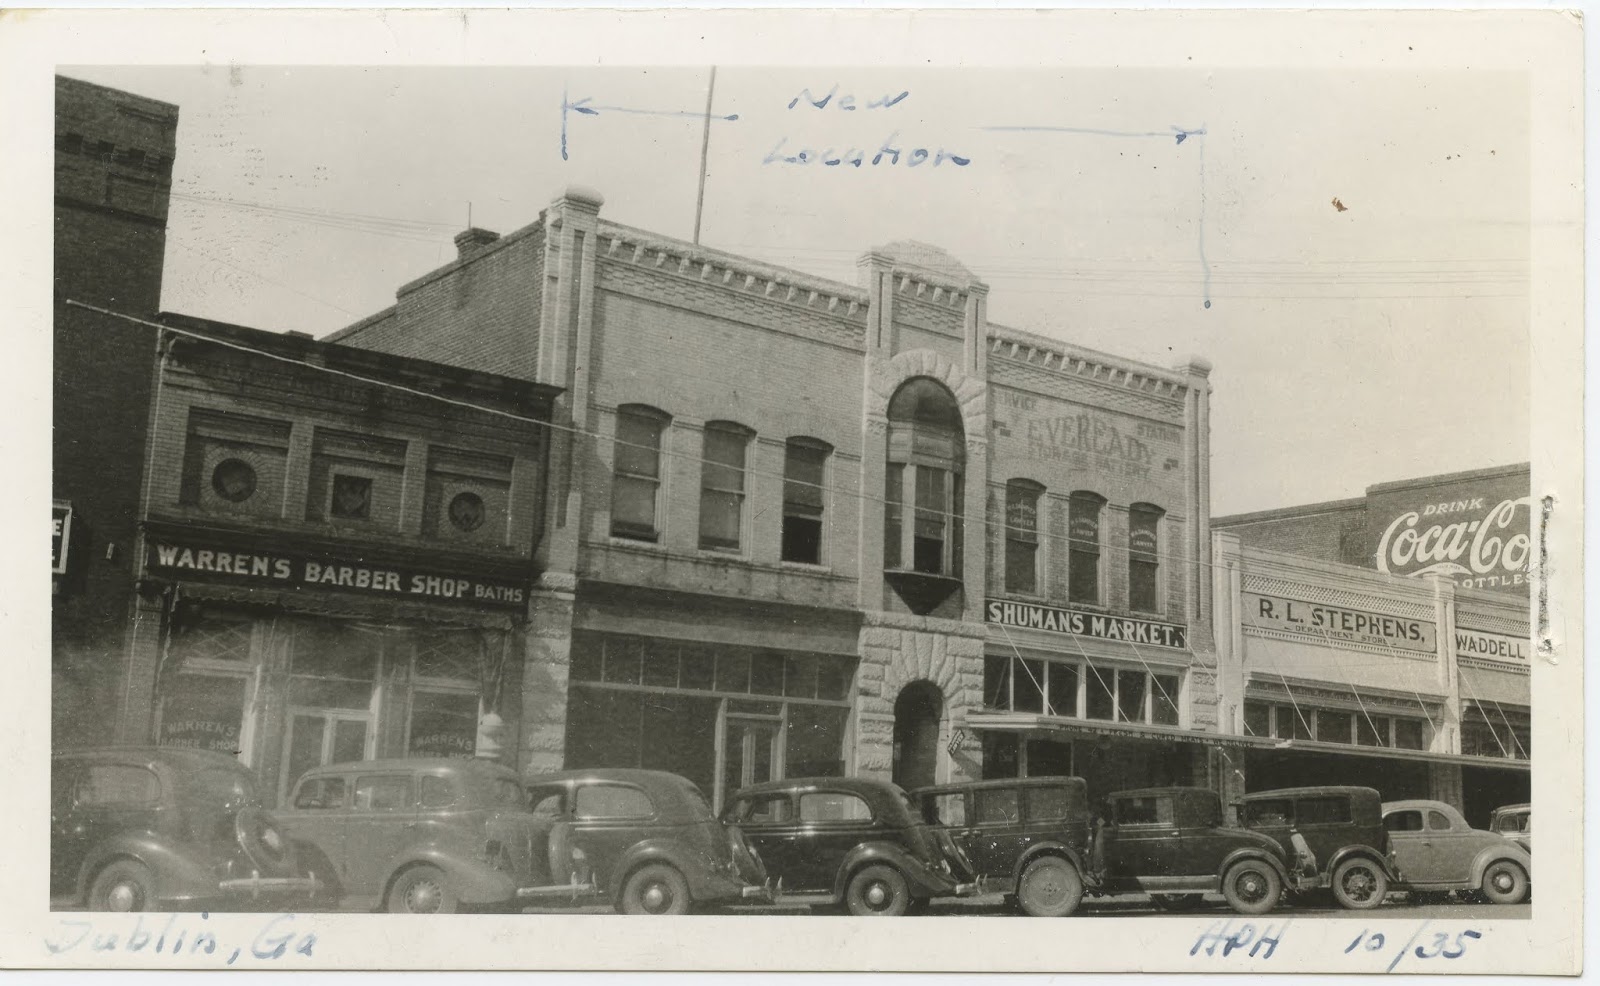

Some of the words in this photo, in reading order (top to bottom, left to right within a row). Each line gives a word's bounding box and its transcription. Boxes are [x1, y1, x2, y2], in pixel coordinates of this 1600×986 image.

[788, 82, 909, 110] New
[762, 129, 971, 168] Location
[1423, 498, 1483, 516] DRINK
[157, 544, 291, 579] WARREN'S
[304, 562, 402, 592] BARBER
[410, 574, 470, 598] SHOP
[474, 583, 523, 602] BATHS
[988, 601, 1085, 634] SHUMAN'S
[1259, 598, 1280, 619] R.
[1287, 602, 1304, 624] L.
[1312, 607, 1426, 643] STEPHENS,
[1295, 625, 1354, 640] DEPARTMENT
[1361, 635, 1388, 645] STORE
[1455, 633, 1526, 660] WADDELL
[167, 719, 237, 737] WARREN'S
